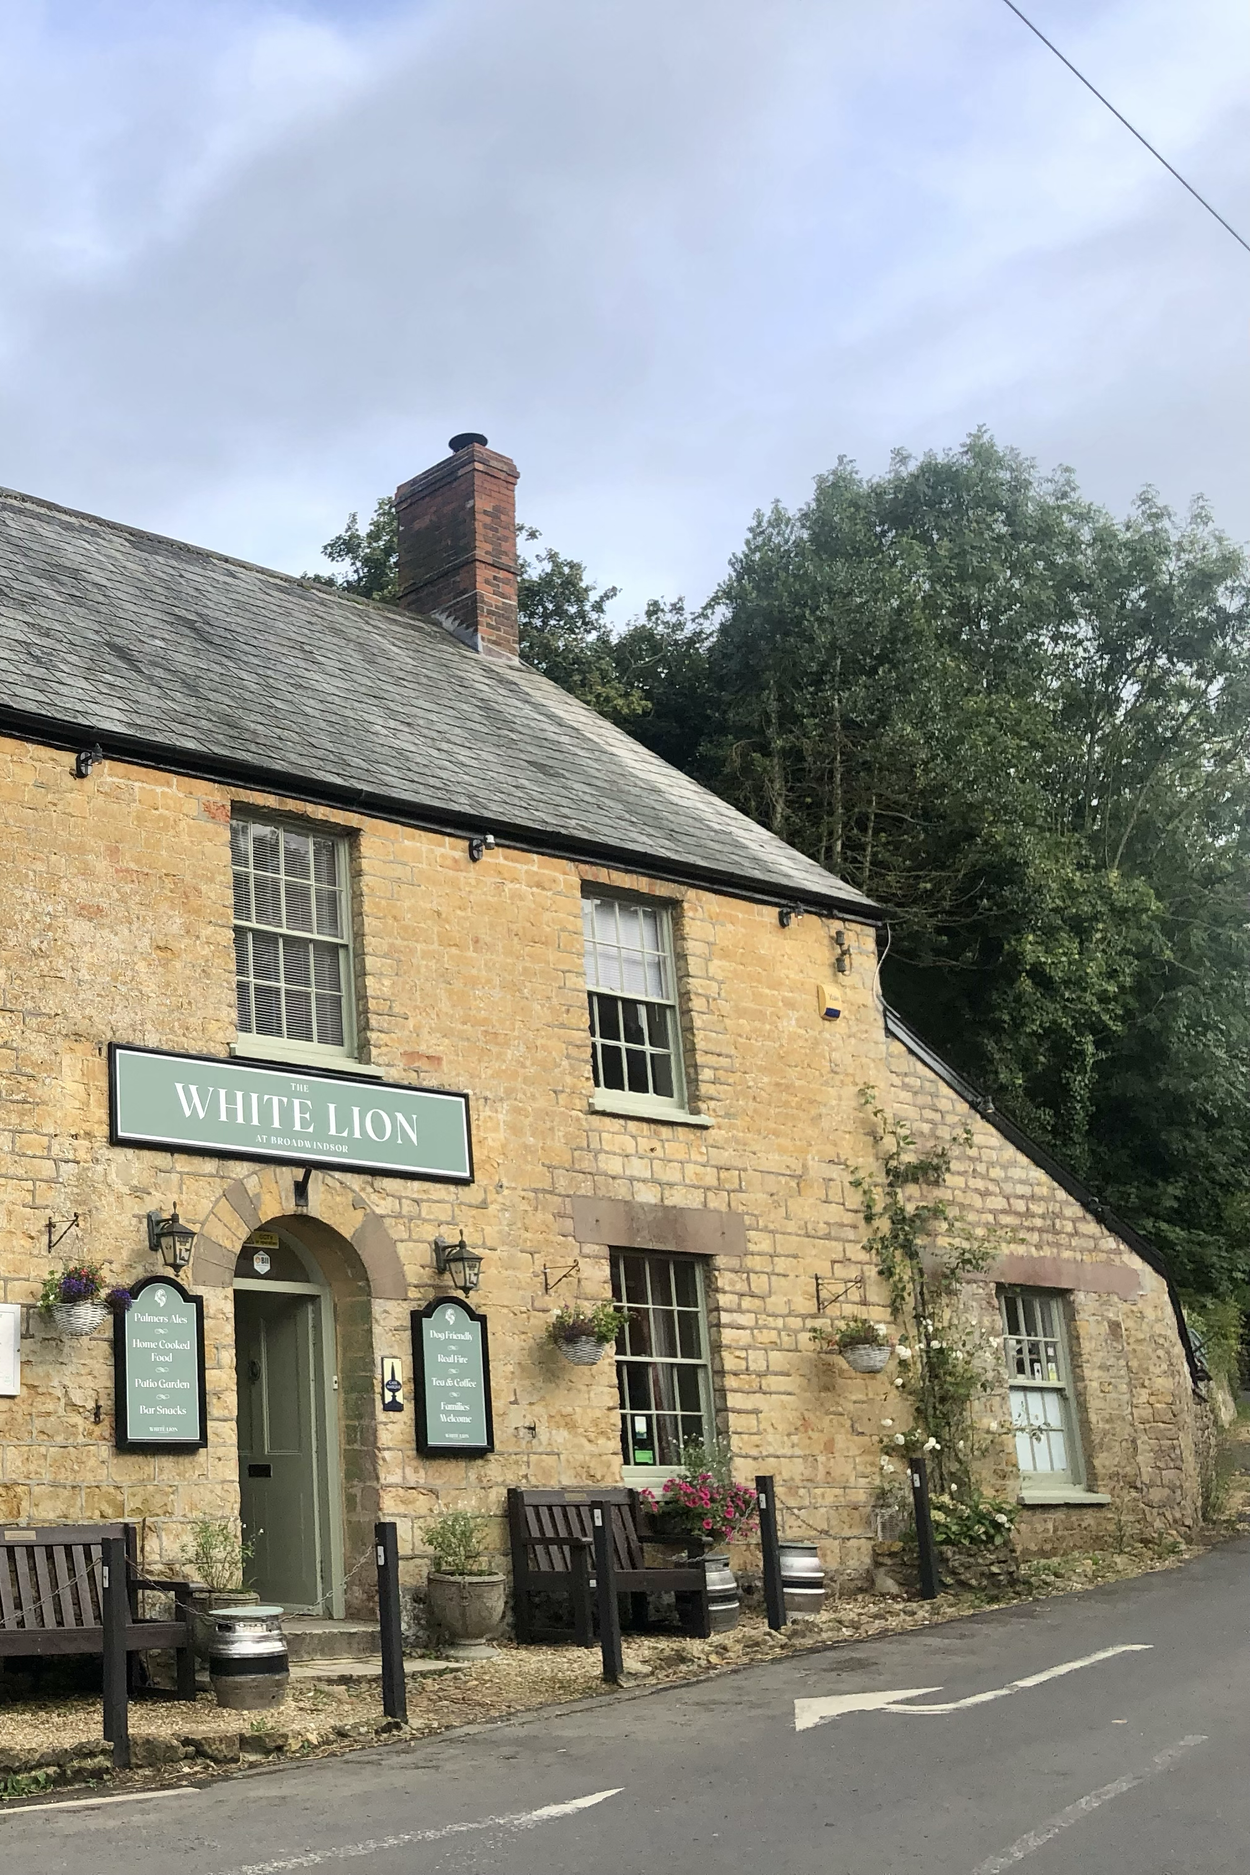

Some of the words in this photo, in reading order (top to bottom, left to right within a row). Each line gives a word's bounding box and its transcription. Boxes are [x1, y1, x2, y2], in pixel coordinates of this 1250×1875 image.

[290, 1082, 310, 1093] THE
[174, 1082, 315, 1133] WHITE
[328, 1103, 418, 1146] LION
[255, 1134, 268, 1143] AT
[271, 1136, 349, 1152] BROADWINDSOR
[134, 1313, 168, 1323] Palmers
[170, 1315, 188, 1324] Ales
[430, 1330, 445, 1341] Dog
[445, 1331, 473, 1342] Friendly
[133, 1339, 157, 1349] Home
[159, 1340, 190, 1350] Cooked
[152, 1353, 172, 1362] Food
[438, 1354, 454, 1363] Real
[454, 1355, 468, 1364] Fire
[135, 1379, 157, 1388] Patio
[159, 1379, 190, 1389] Garden
[432, 1377, 445, 1387] Tea
[446, 1378, 453, 1387] &
[454, 1378, 477, 1388] Coffee
[140, 1405, 155, 1414] Bar
[157, 1405, 187, 1415] Snacks
[441, 1402, 470, 1411] Families
[440, 1414, 472, 1424] Welcome
